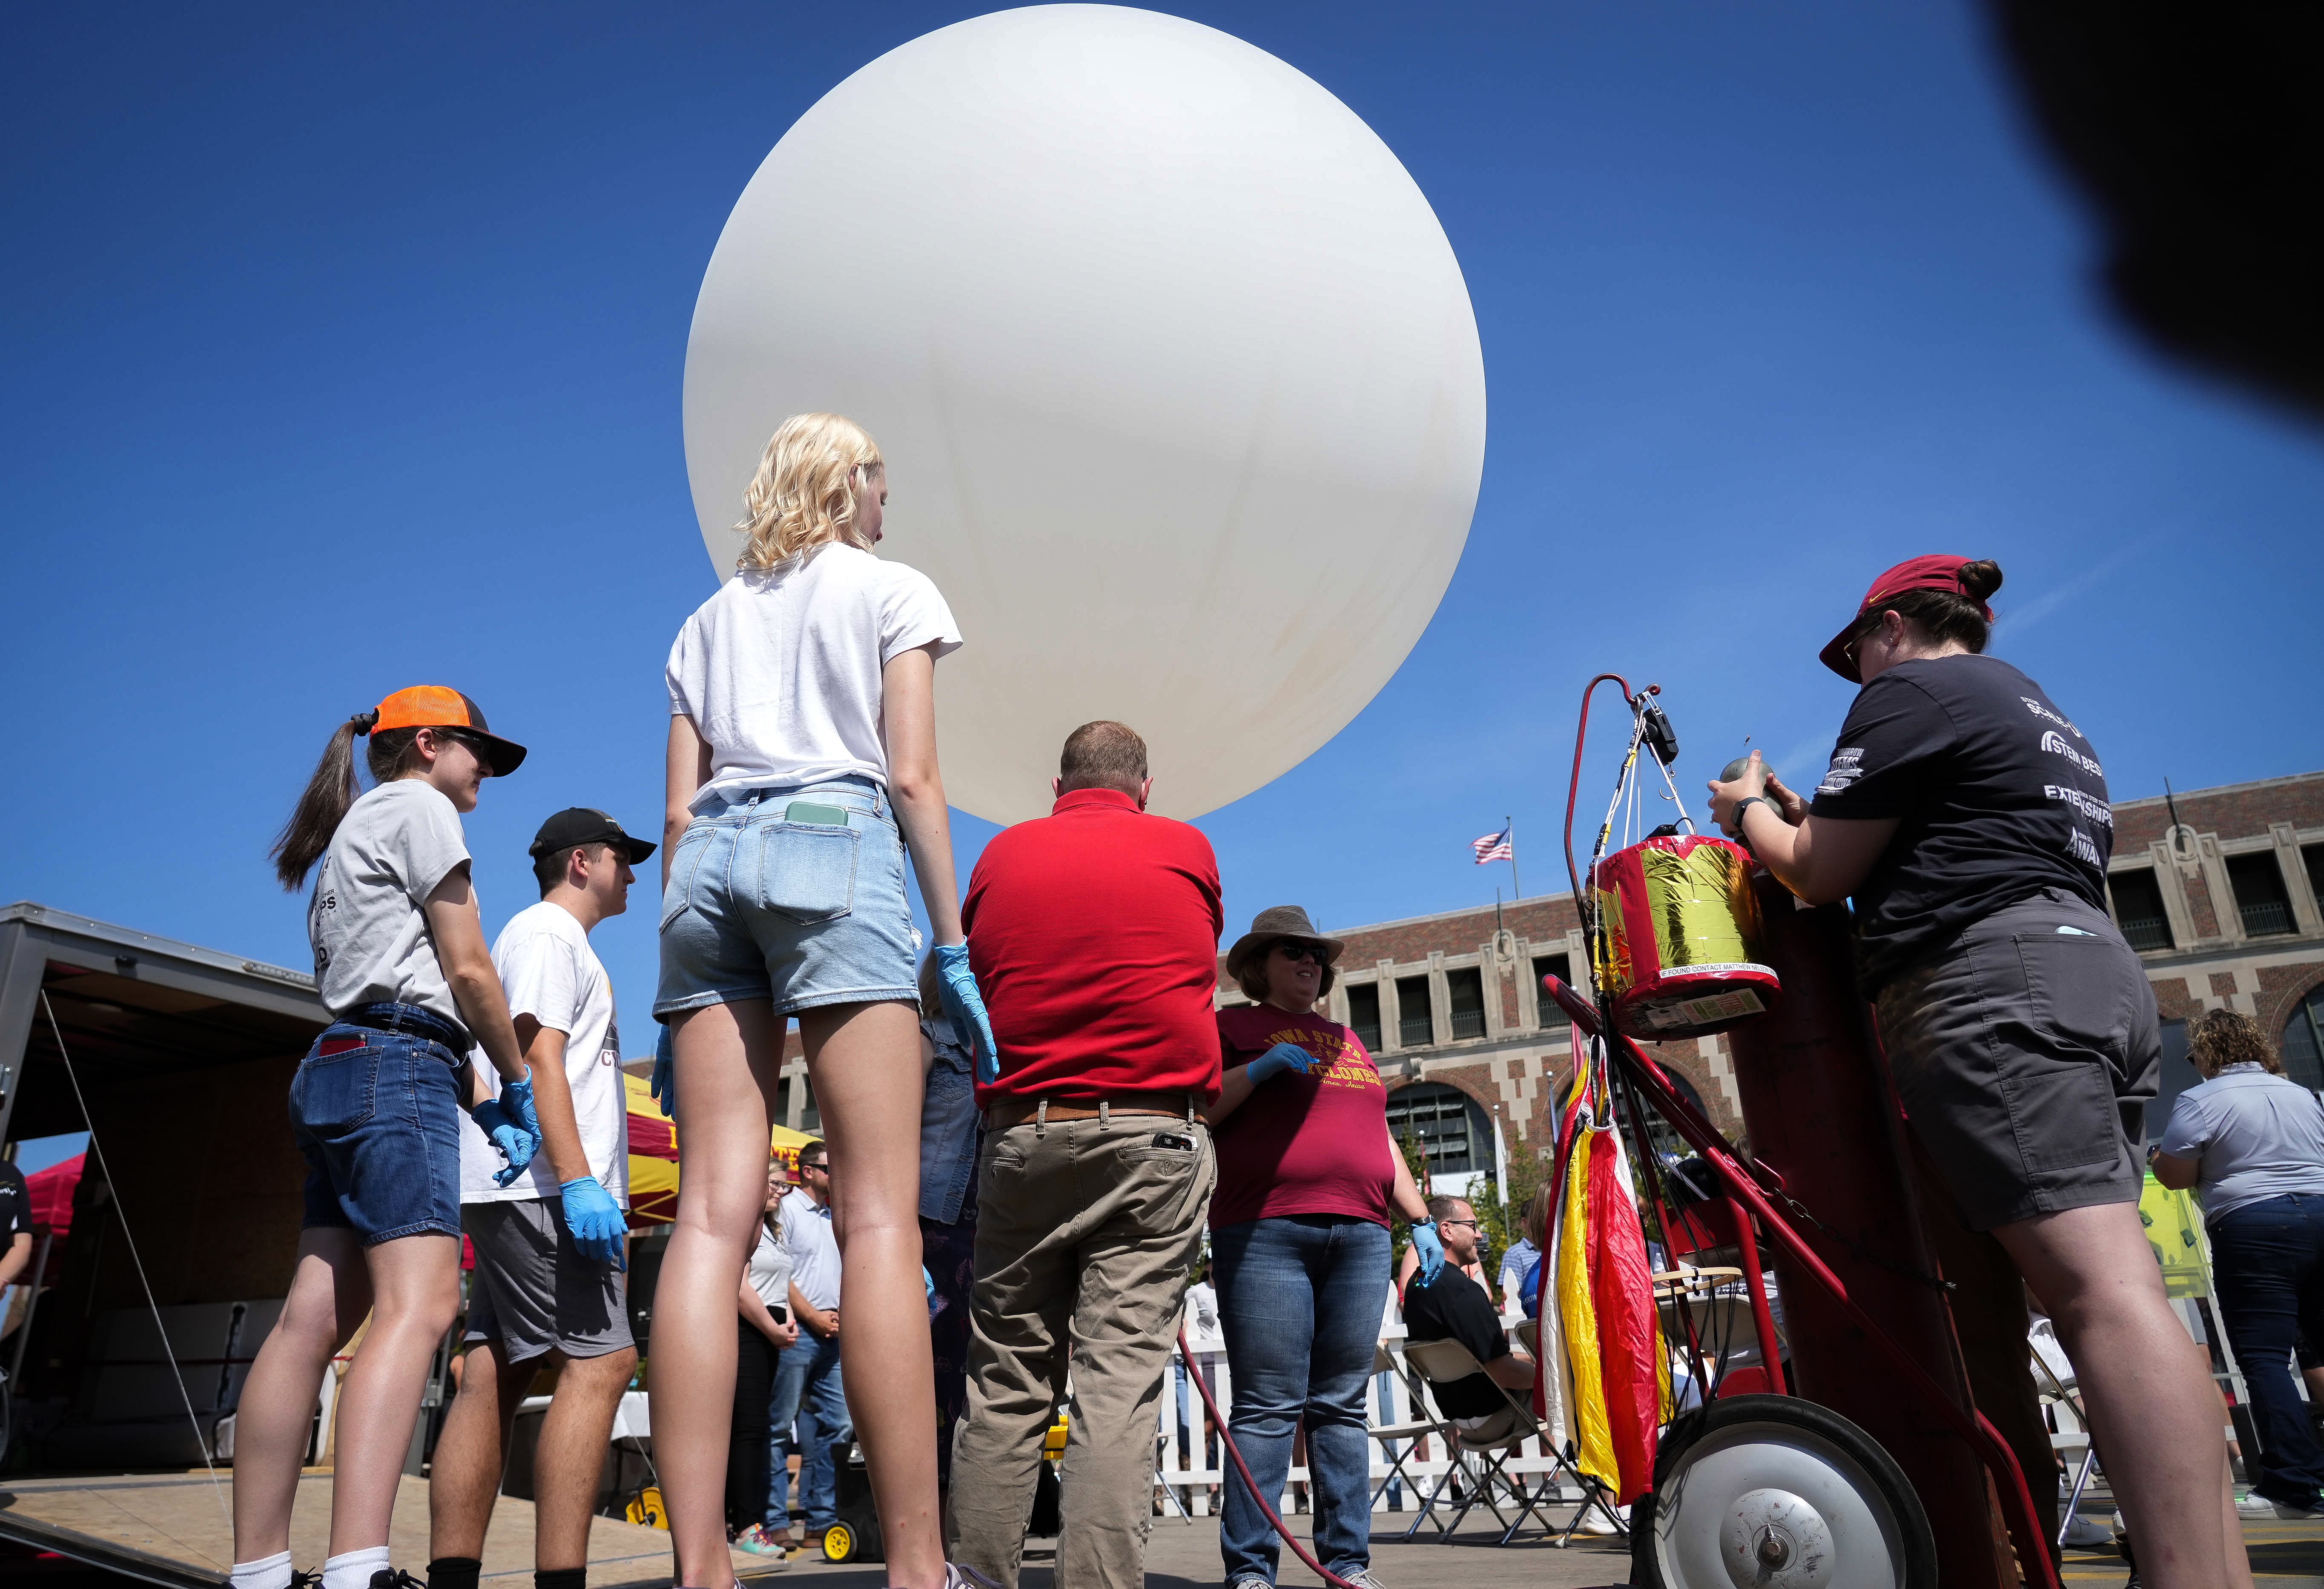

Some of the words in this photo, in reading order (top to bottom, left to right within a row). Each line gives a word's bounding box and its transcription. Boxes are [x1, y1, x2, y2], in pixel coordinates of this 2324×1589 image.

[2026, 703, 2083, 738] SCALE-U
[2052, 739, 2081, 765] STEM
[2089, 795, 2098, 804] STEM
[1668, 967, 1690, 975] FOUND
[1319, 1077, 1342, 1087] Ames,
[1346, 1081, 1366, 1089] Iowa
